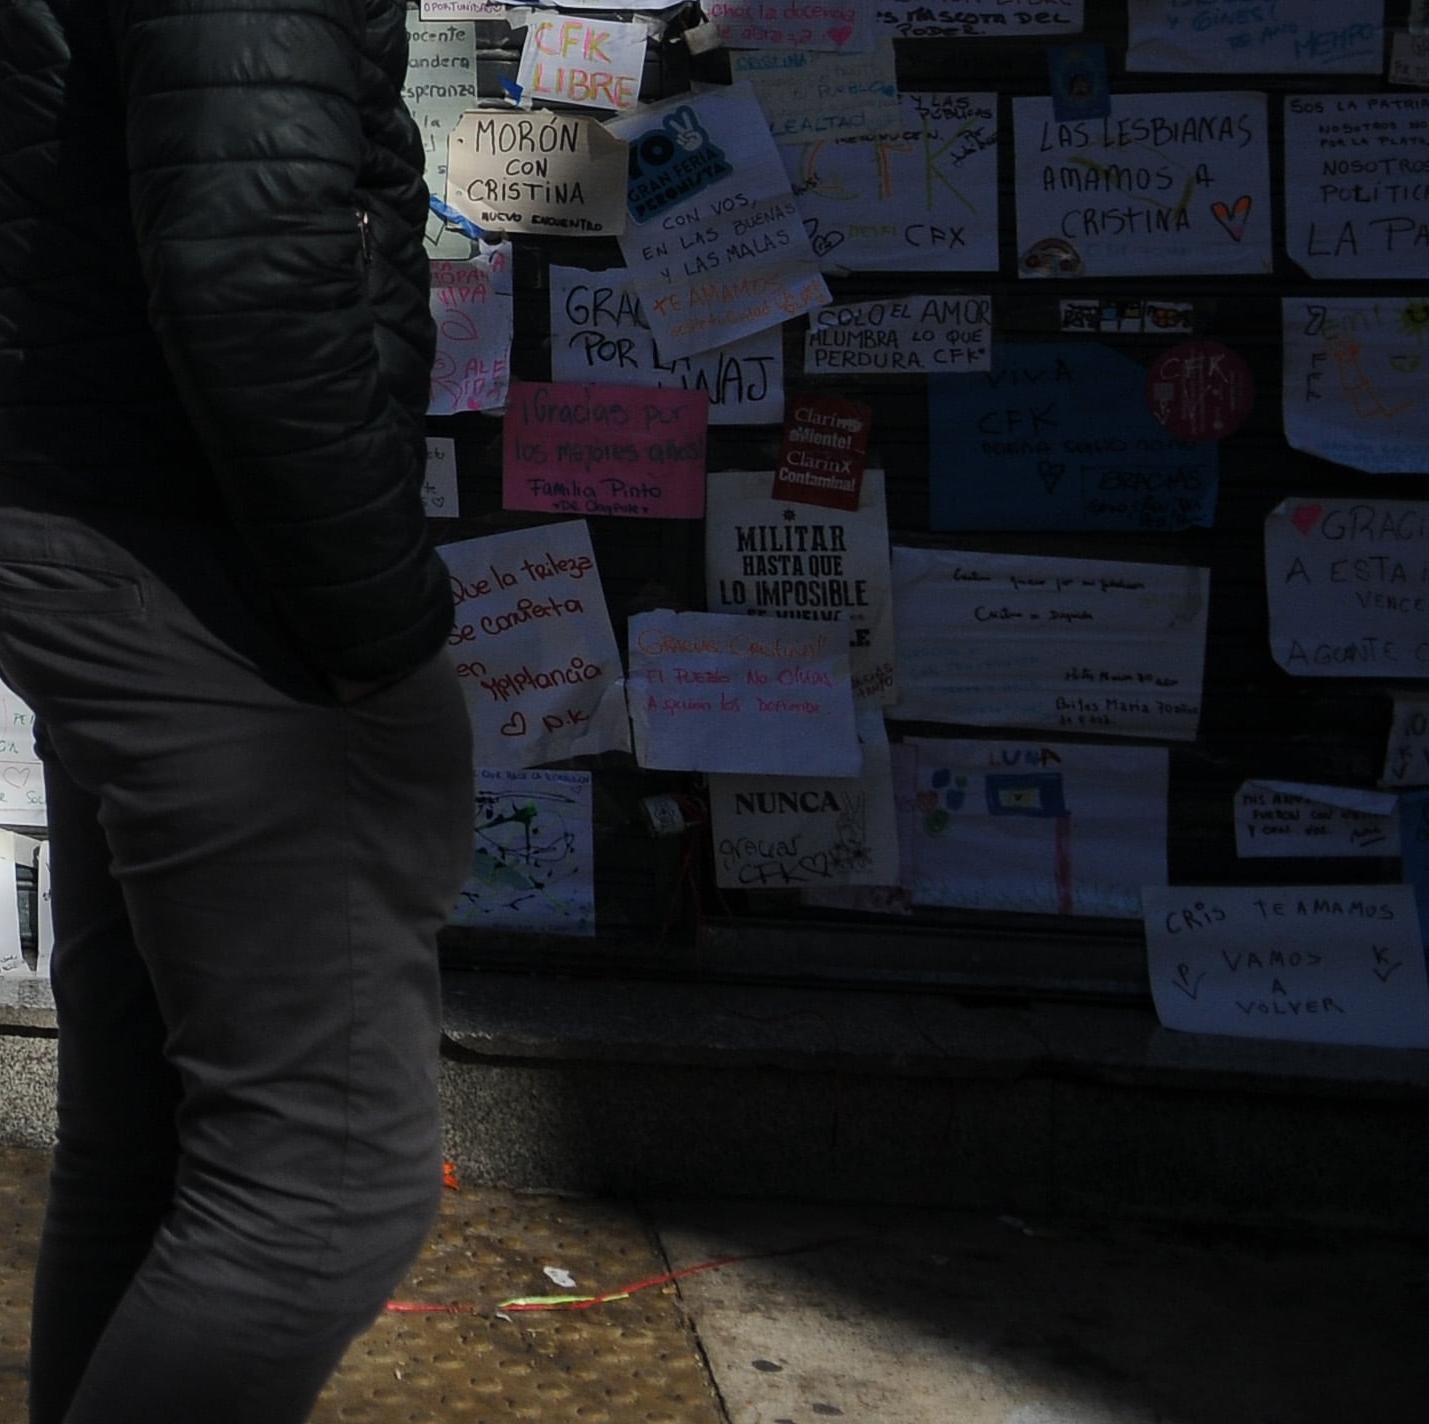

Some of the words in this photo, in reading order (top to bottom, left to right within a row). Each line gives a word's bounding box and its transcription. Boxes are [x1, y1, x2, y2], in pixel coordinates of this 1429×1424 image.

[534, 21, 613, 63] CFK
[533, 65, 638, 109] LIBRE
[475, 117, 579, 155] MORÓN
[505, 158, 549, 178] CON
[734, 525, 847, 554] MILITAR
[743, 555, 803, 577] HASTA
[808, 555, 843, 577] QUE
[719, 579, 746, 607] LO
[734, 790, 841, 815] NUNCA
